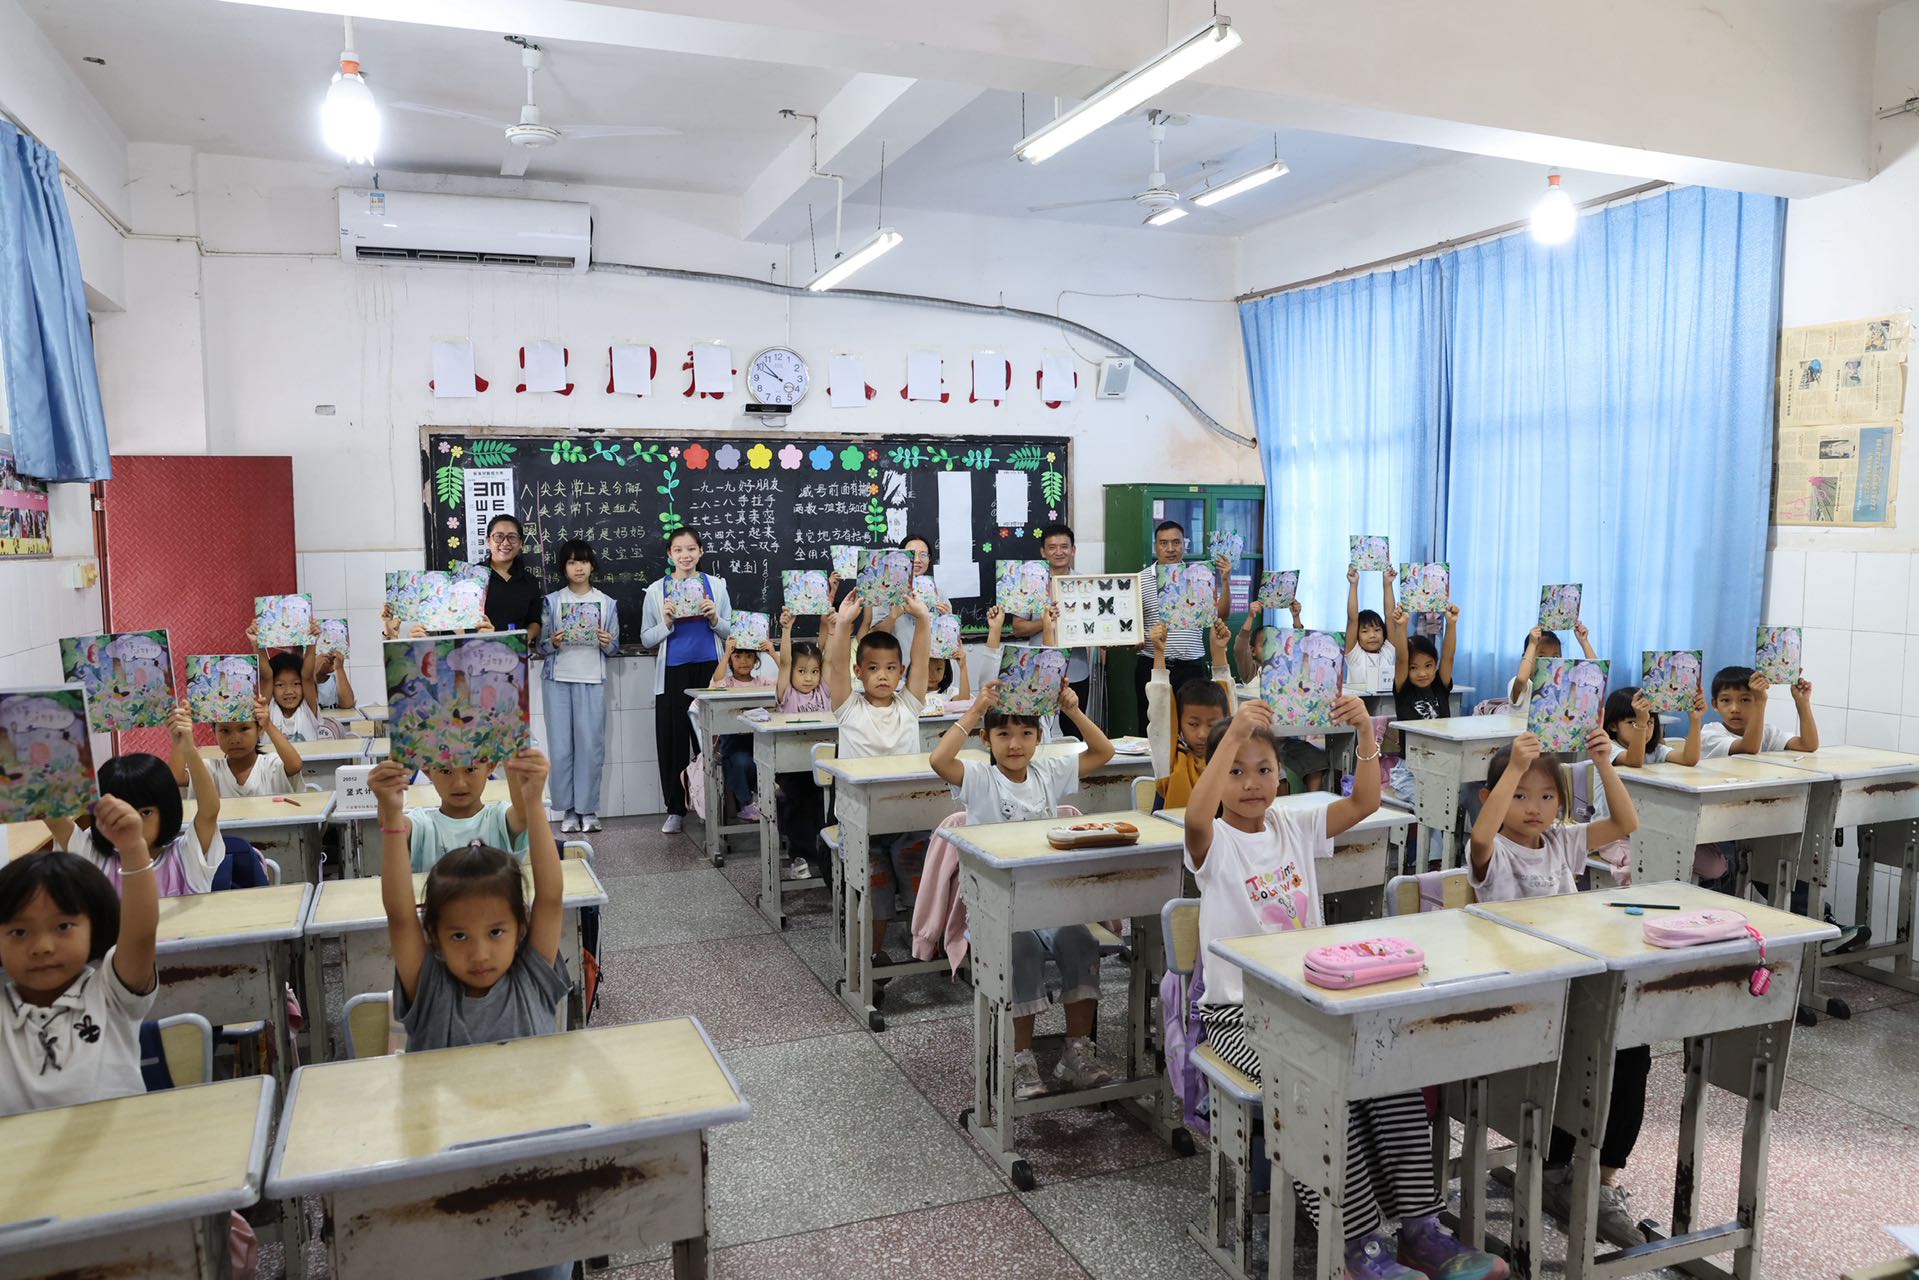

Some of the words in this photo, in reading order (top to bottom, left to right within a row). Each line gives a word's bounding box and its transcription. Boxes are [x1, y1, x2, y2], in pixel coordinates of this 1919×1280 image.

[774, 353, 783, 361] 12
[756, 363, 764, 371] 10
[794, 364, 800, 372] 2
[753, 374, 760, 382] 9
[797, 375, 803, 383] 3
[794, 385, 800, 393] 4
[765, 393, 771, 401] 7
[775, 395, 781, 403] 6
[787, 393, 793, 401] 5
[691, 477, 783, 493] 一九一九好朋友
[689, 494, 776, 509] 二八二八手拉手
[698, 524, 776, 540] 六四六一起来
